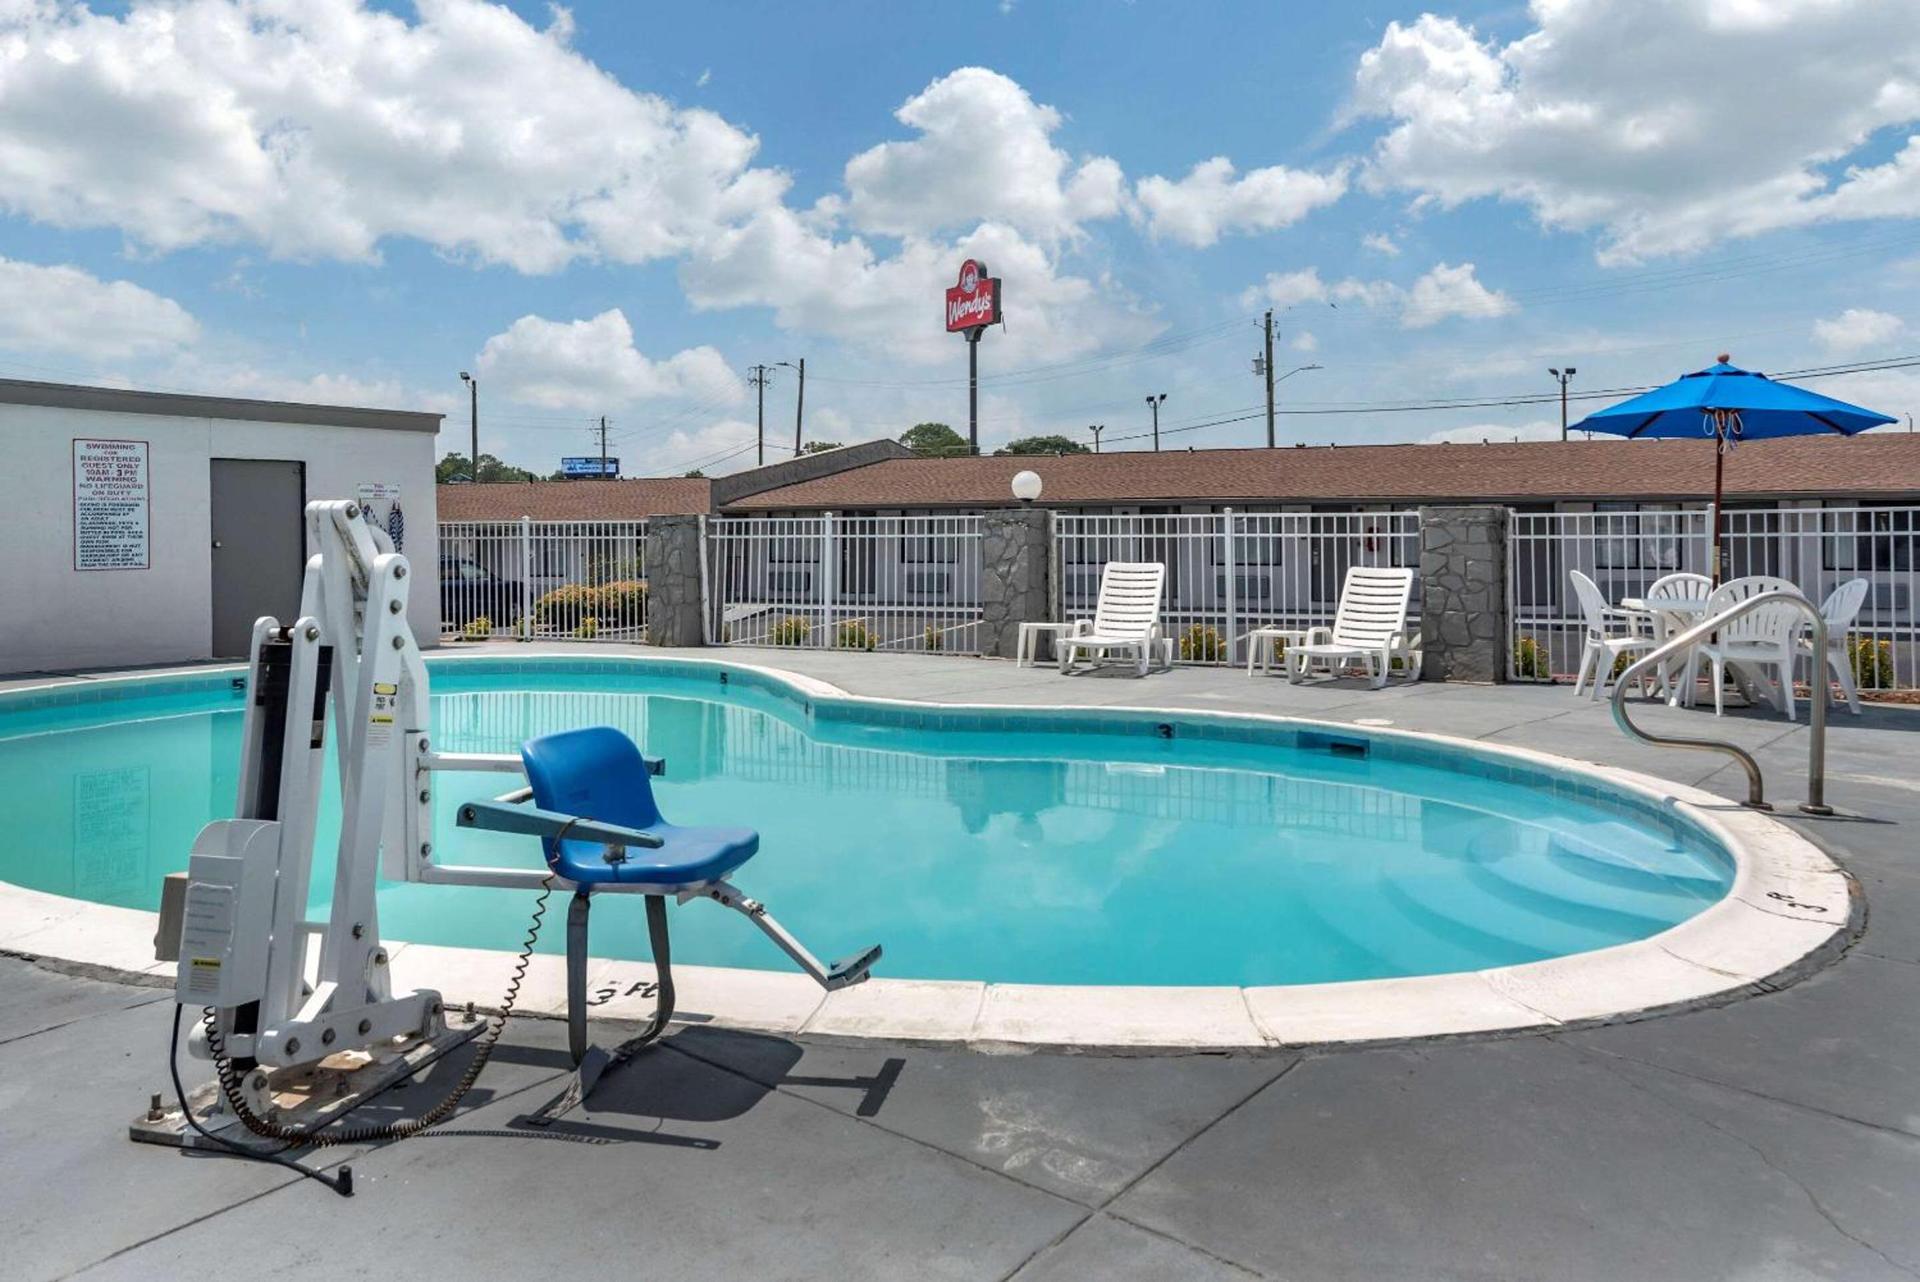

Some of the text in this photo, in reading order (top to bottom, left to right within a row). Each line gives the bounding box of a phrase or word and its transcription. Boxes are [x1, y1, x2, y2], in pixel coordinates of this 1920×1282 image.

[948, 288, 991, 326] Wendy's
[720, 672, 728, 684] 5
[1158, 723, 1173, 739] 3
[586, 988, 617, 1006] 3
